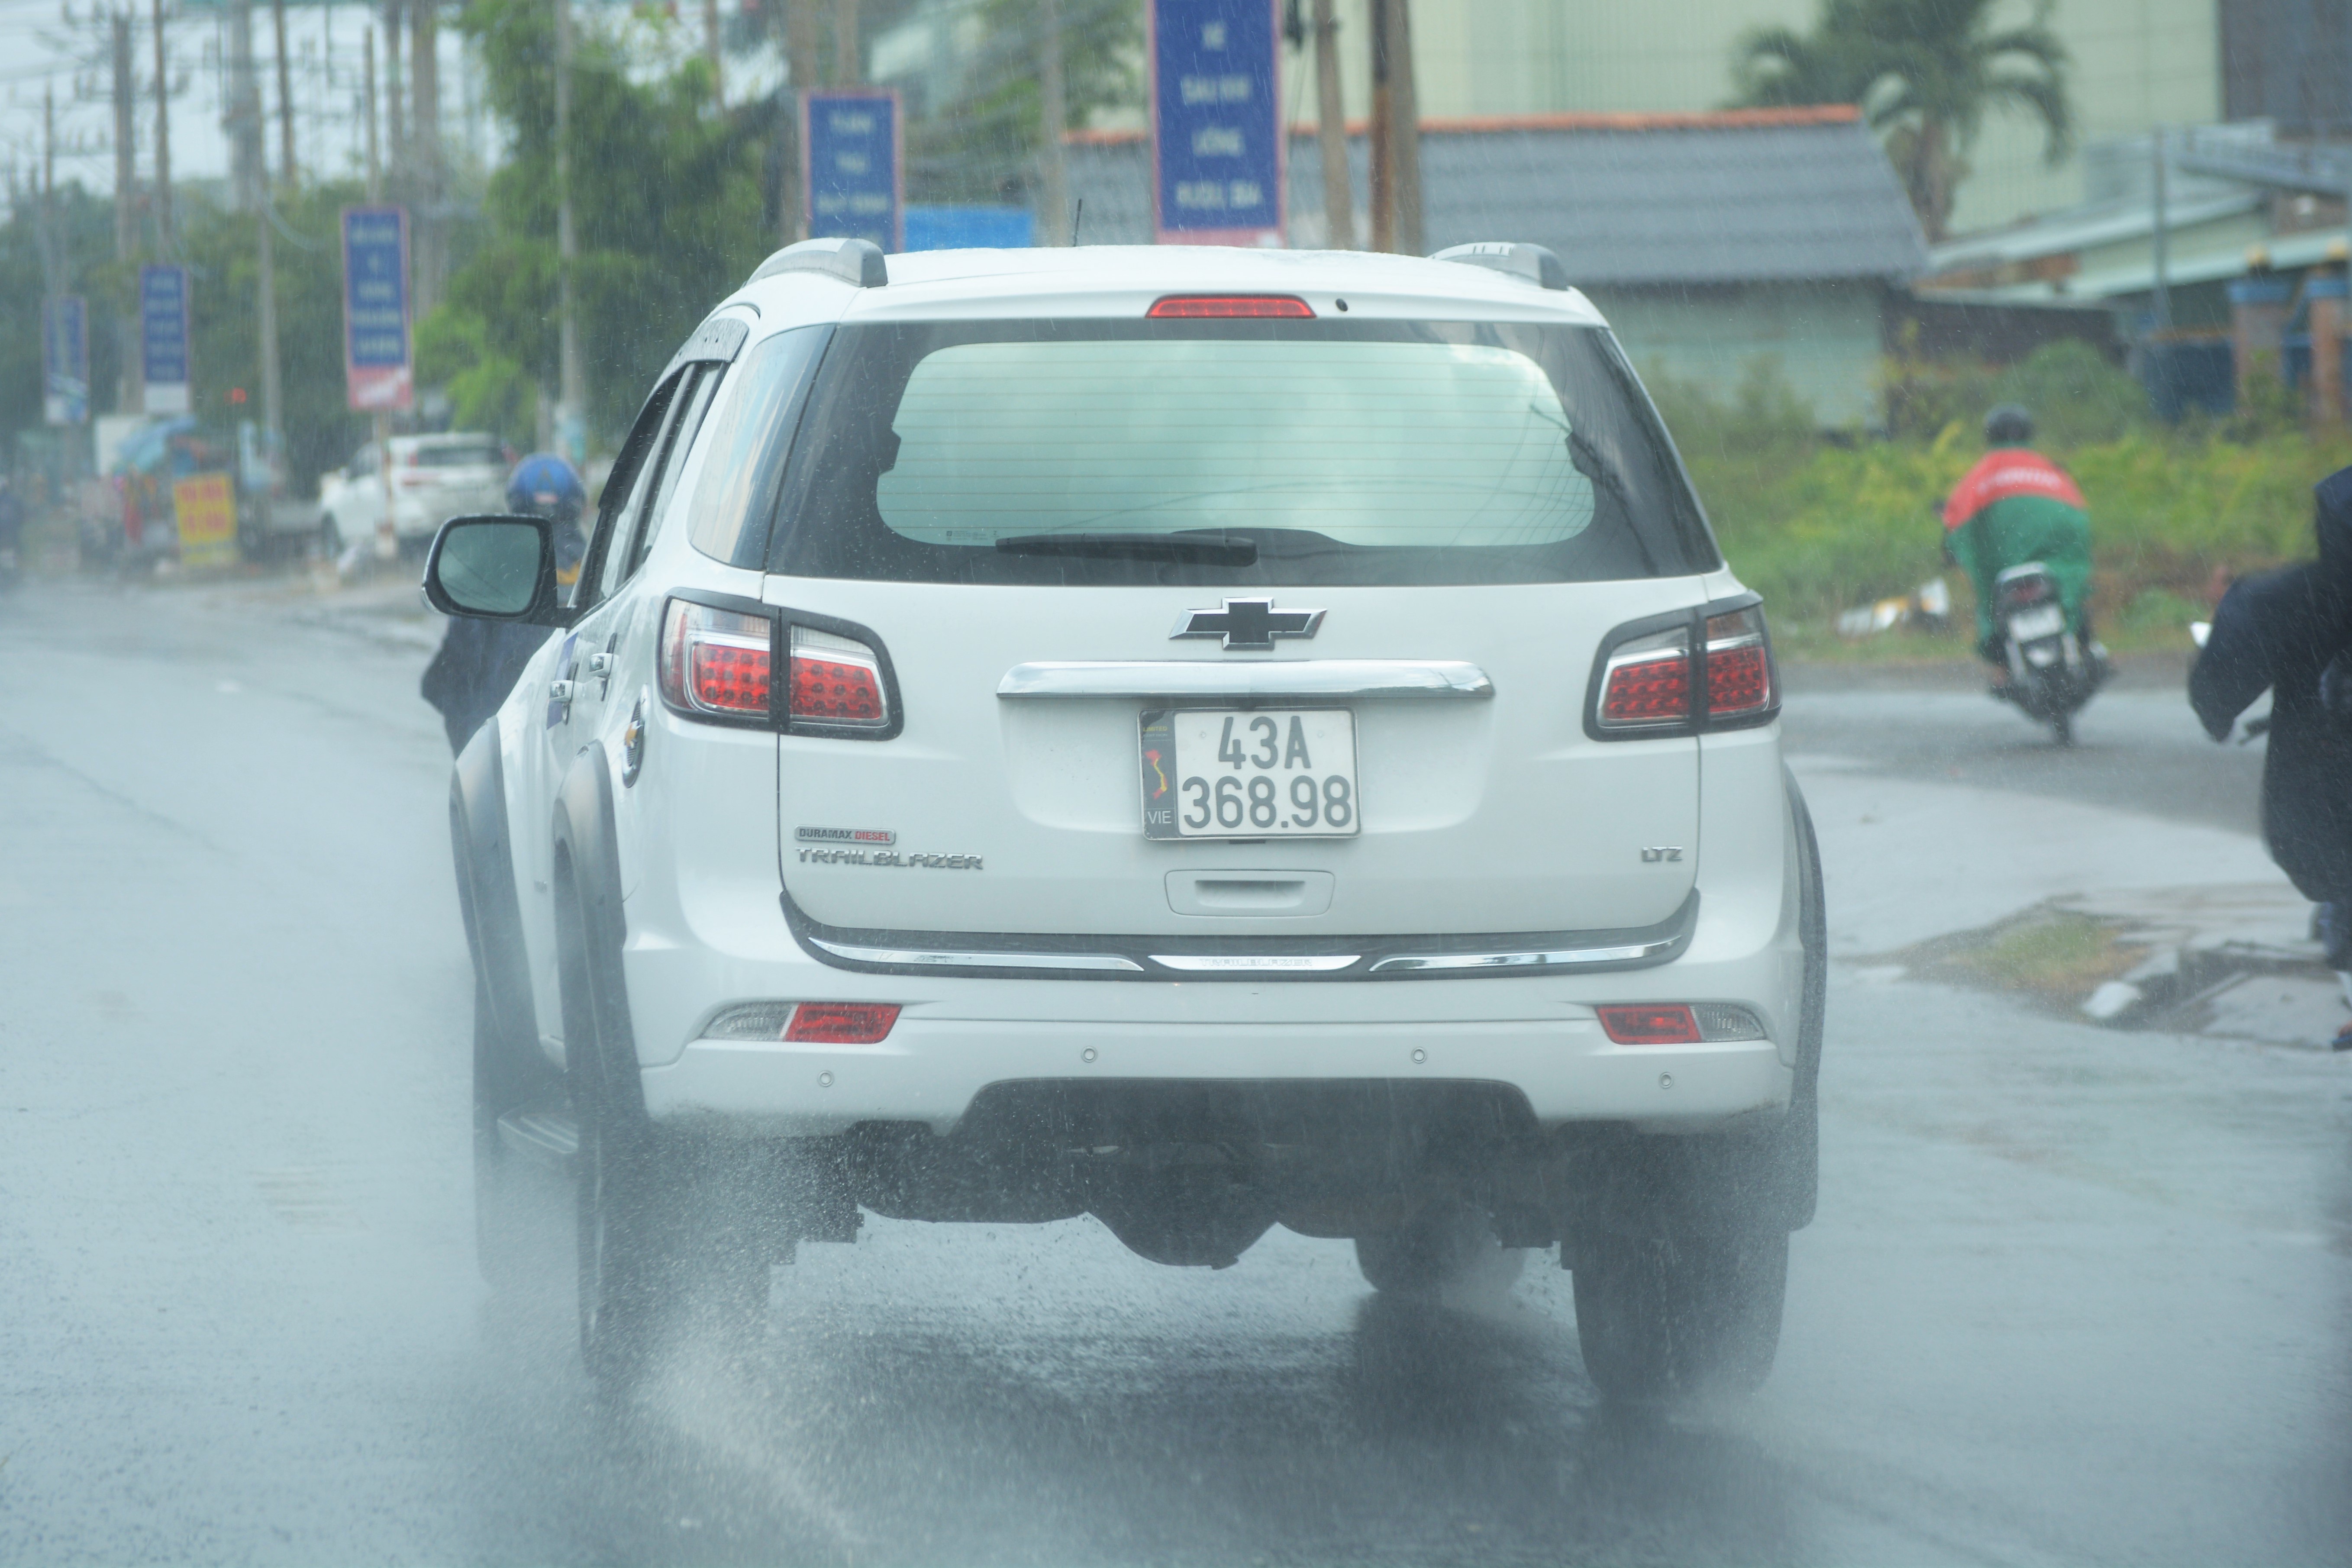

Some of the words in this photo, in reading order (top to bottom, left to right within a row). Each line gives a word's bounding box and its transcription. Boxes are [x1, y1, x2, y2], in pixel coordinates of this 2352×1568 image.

[1218, 716, 1311, 770] 43A
[1182, 775, 1351, 828] 368.98
[1147, 811, 1171, 824] VIE
[799, 828, 852, 839] DURAMAX
[855, 831, 890, 841] DIESEL
[796, 847, 983, 870] TRAILBLAZER
[1642, 846, 1683, 862] LTZ
[1199, 958, 1312, 967] TRAILBLAZER
